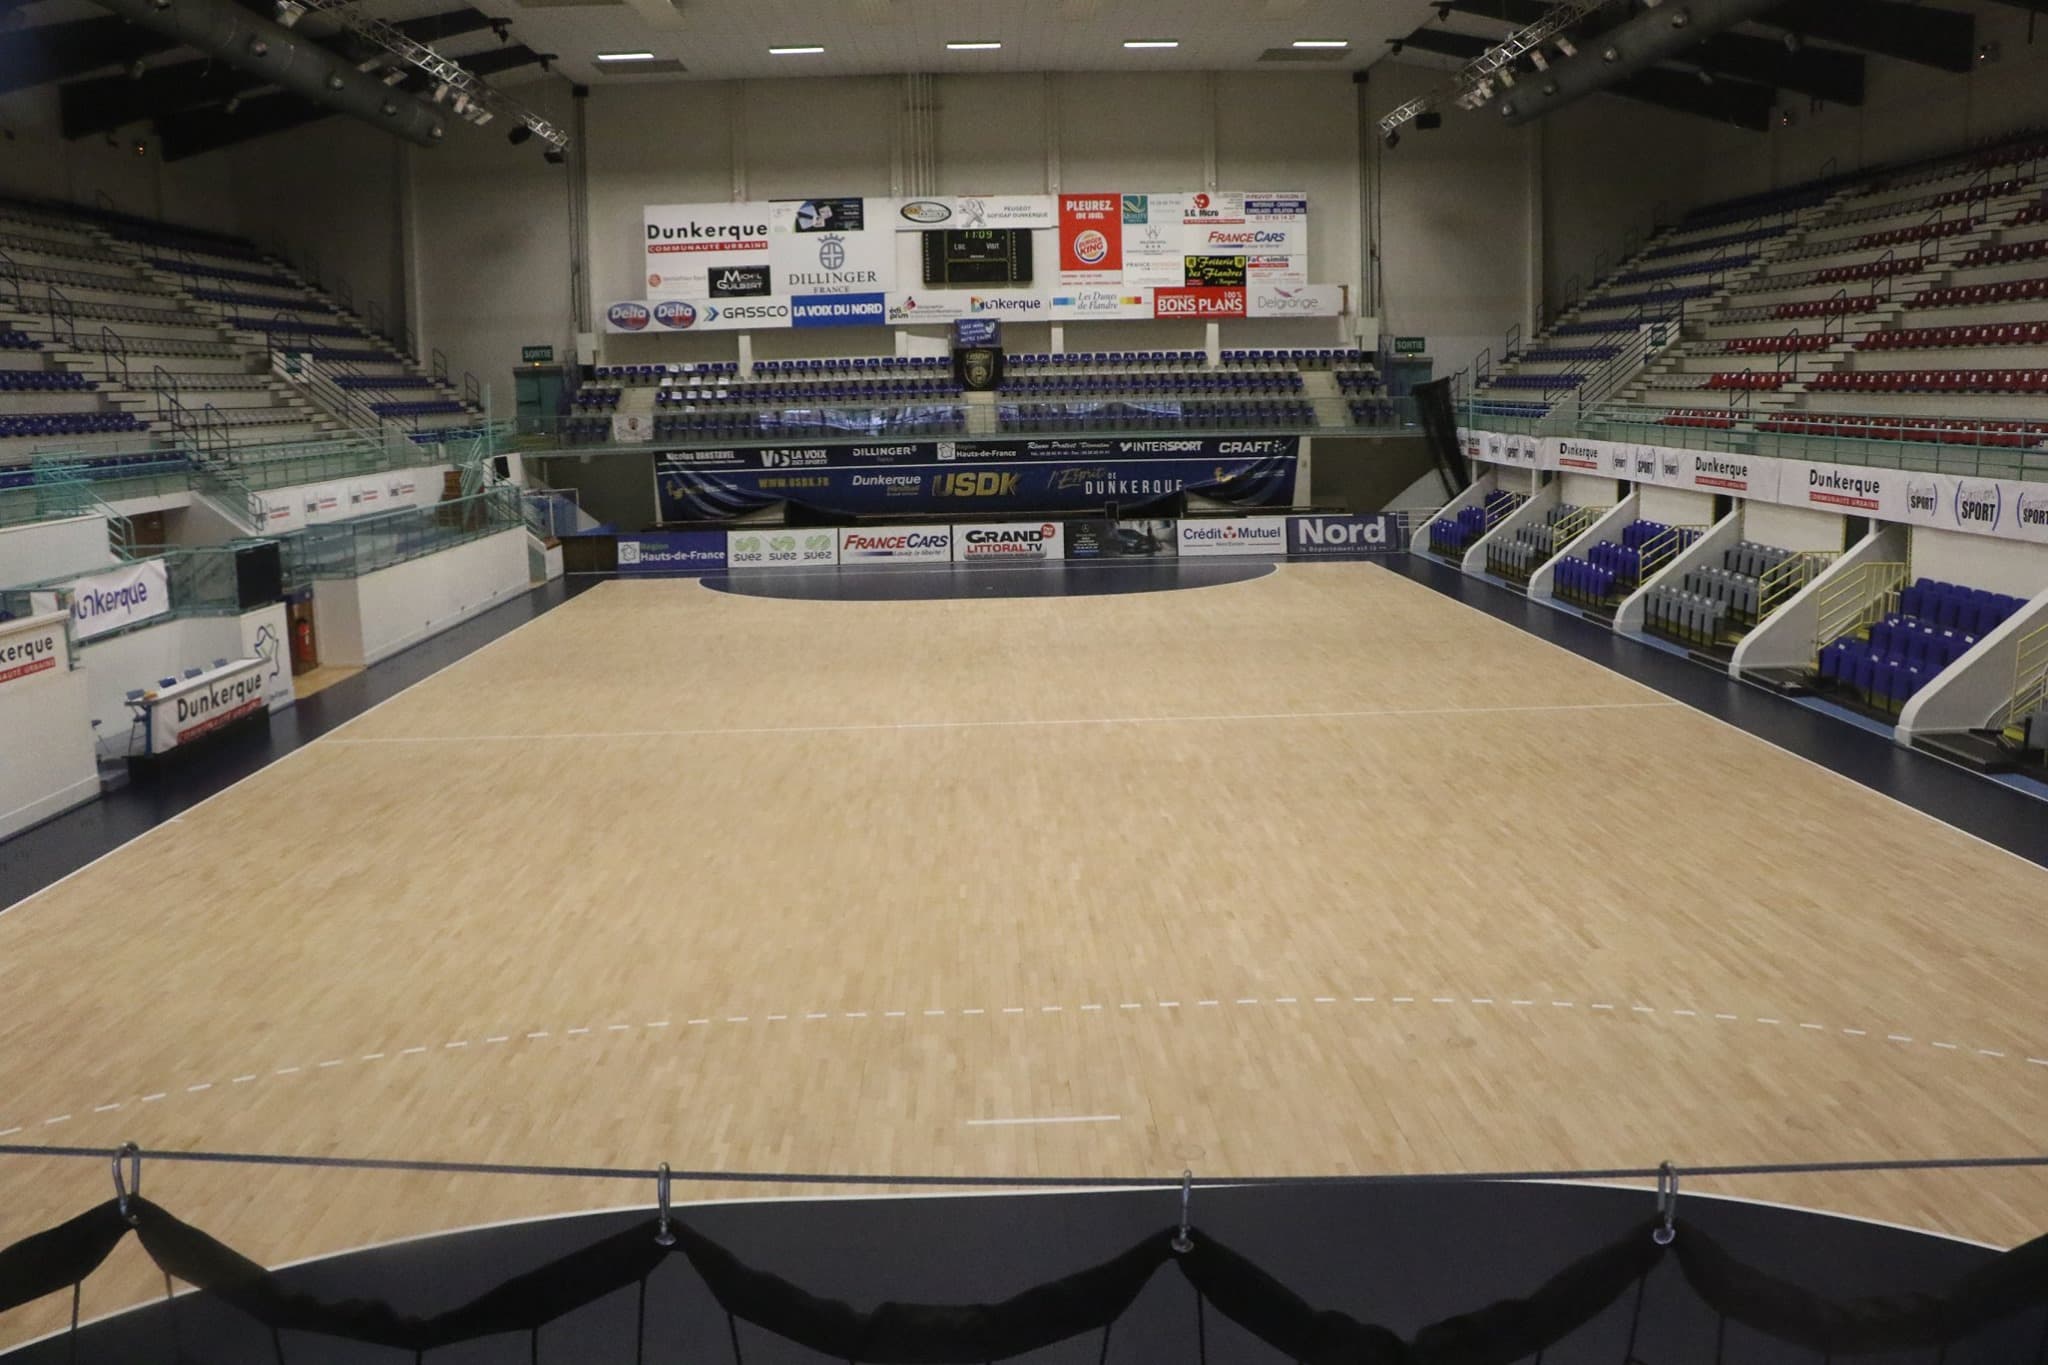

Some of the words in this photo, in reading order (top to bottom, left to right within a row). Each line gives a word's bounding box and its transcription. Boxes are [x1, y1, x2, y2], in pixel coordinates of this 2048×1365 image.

[647, 221, 768, 240] Dunkerque
[649, 243, 720, 252] COMMUNAUTÉ
[724, 241, 767, 249] URBAINE
[1080, 243, 1104, 254] KING
[1198, 257, 1233, 267] Friterie
[789, 271, 877, 285] DILLINGER
[1189, 269, 1200, 277] des
[1203, 268, 1242, 279] Flandres
[1077, 292, 1091, 300] Les
[1093, 291, 1117, 300] Dunes
[658, 304, 692, 318] Delta
[793, 306, 806, 317] LA
[808, 305, 834, 316] VOIX
[835, 304, 850, 315] DU
[852, 303, 882, 314] NORD
[1077, 301, 1088, 309] de
[1089, 300, 1118, 309] Flandre
[1157, 299, 1196, 311] BONS
[1199, 298, 1243, 311] PLANS
[612, 306, 646, 319] Delta
[723, 306, 788, 318] GASSCO
[852, 446, 912, 457] DILLINGER
[1133, 441, 1202, 451] INTERSPORT
[1218, 441, 1272, 453] CRAFT
[1560, 443, 1598, 459] Dunkerque
[791, 451, 802, 459] LA
[803, 450, 827, 459] VOIX
[956, 450, 1017, 458] Hauts-de-France
[1638, 460, 1654, 475] SPORT
[1696, 456, 1747, 479] Dunkerque
[852, 475, 921, 488] Dunkerque
[932, 472, 1021, 497] USDK
[1809, 469, 1880, 496] Dunkerque
[1910, 496, 1934, 511] SPORT
[1961, 500, 1996, 522] SPORT
[966, 530, 1044, 543] GRAND
[1183, 527, 1222, 540] Crédit
[1238, 526, 1281, 538] Mutuel
[1298, 516, 1386, 544] Nord
[967, 543, 1043, 553] LITTORAL.TV
[640, 551, 725, 561] Hauts-de-France
[733, 553, 762, 562] suez
[769, 552, 797, 561] suez
[803, 551, 832, 560] suez
[177, 674, 262, 722] Dunkerque
